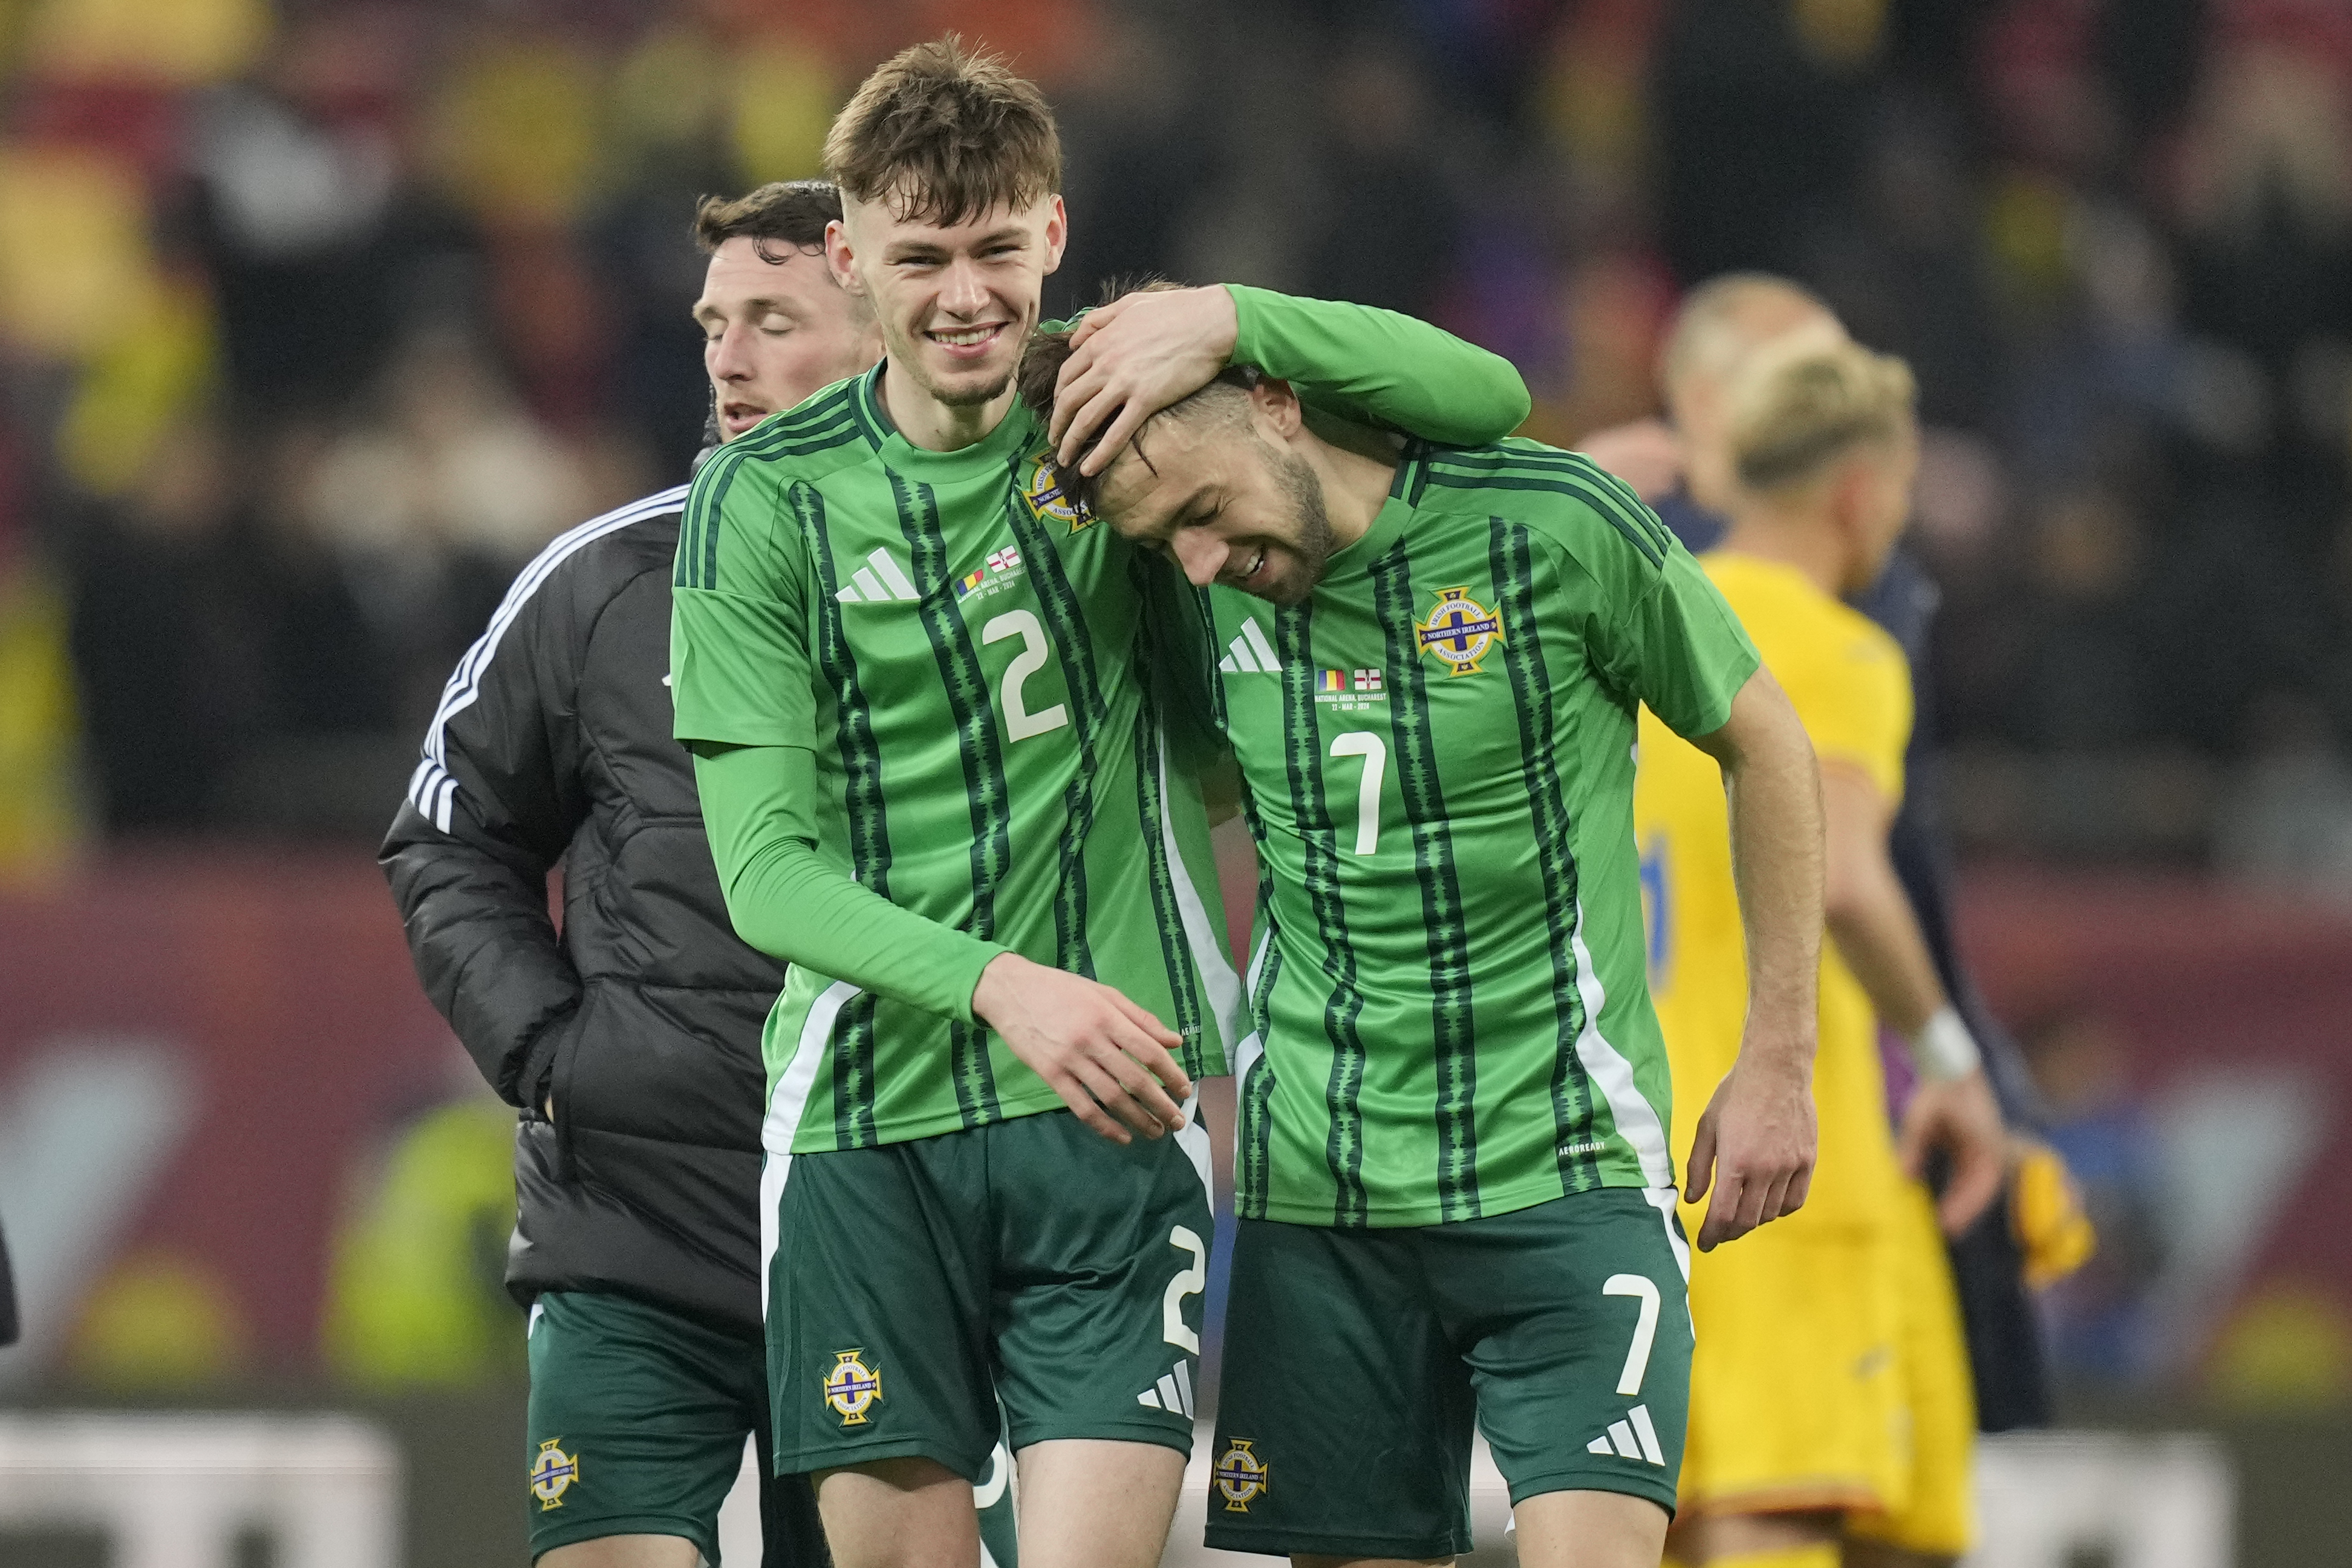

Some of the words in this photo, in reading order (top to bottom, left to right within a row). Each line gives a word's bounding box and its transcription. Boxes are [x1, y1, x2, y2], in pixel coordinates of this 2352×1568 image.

[1427, 627, 1461, 640] NORTHERN
[1462, 623, 1490, 634] IRELAND
[1431, 608, 1446, 625] IRISH
[1446, 602, 1481, 619] FOOTBALL
[982, 609, 1069, 743] 2
[1438, 641, 1485, 660] ASSOCIATION
[1329, 731, 1386, 856] 7
[1559, 1141, 1605, 1156] AEROREADY
[1162, 1225, 1206, 1356] 2
[1602, 1274, 1661, 1396] 7
